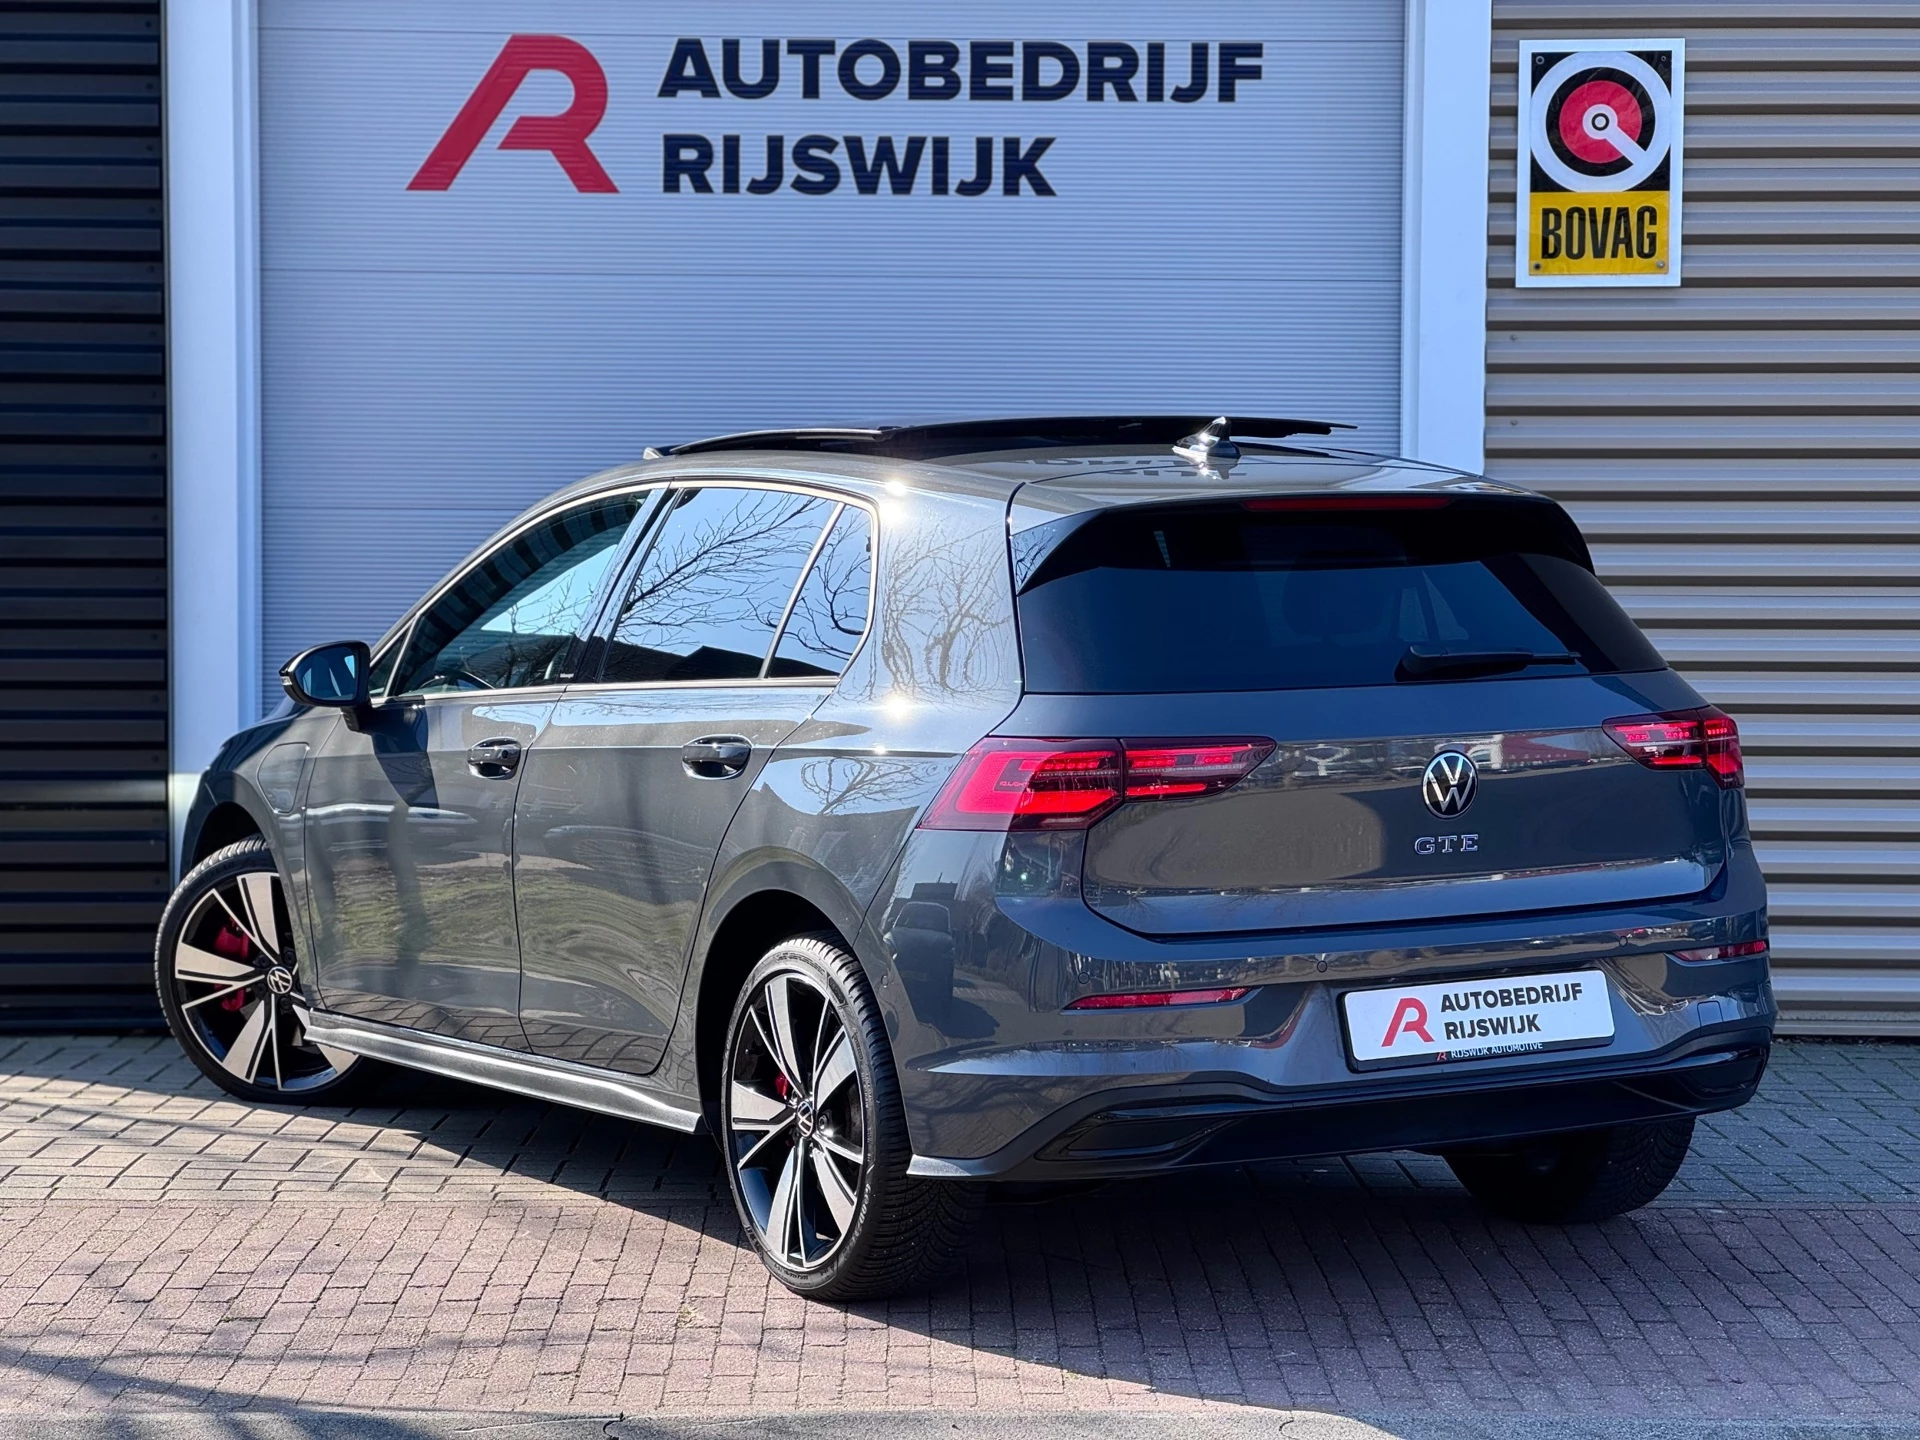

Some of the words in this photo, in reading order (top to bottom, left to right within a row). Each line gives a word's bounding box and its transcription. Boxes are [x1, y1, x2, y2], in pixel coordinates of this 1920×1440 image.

[657, 37, 1264, 104] AUTOBEDRIJF
[662, 133, 1058, 197] RIJSWIJK
[1541, 205, 1658, 260] BOVAG
[1414, 833, 1478, 855] GTE
[1440, 982, 1583, 1013] AUTOBEDRIJF
[1444, 1013, 1542, 1041] RIJSWIJK
[1451, 1046, 1490, 1059] RIJSWIJK
[1491, 1041, 1543, 1055] AUTOMOTIVE
